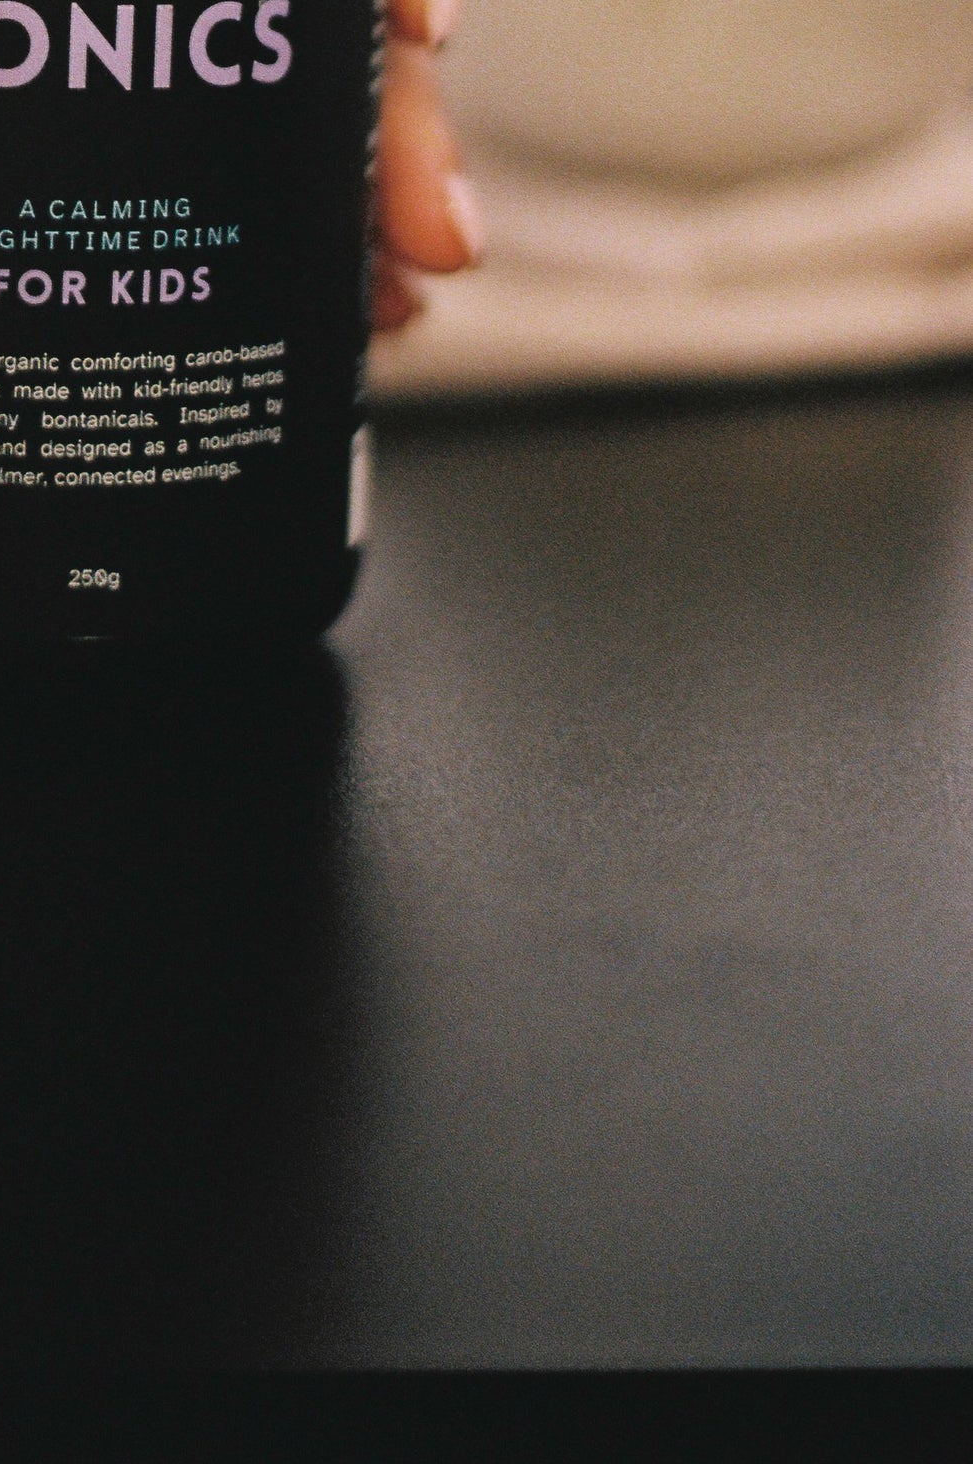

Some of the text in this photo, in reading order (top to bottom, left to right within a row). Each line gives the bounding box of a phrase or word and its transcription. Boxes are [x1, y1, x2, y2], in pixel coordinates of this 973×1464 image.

[19, 197, 191, 219] A CALMING
[153, 225, 240, 249] DRINK
[111, 266, 211, 305] KIDS
[71, 351, 176, 373] comforting
[185, 339, 286, 368] carob-based
[13, 382, 70, 400] made
[81, 381, 123, 400] with
[133, 377, 234, 399] kid-friendly
[242, 369, 285, 388] herbs
[41, 410, 159, 430] bontanicals.
[180, 399, 250, 425] Inspired
[265, 397, 284, 415] by
[40, 434, 132, 462] designed
[144, 440, 166, 457] as
[177, 438, 188, 454] a
[199, 425, 282, 450] nourishing
[54, 466, 156, 486] connected
[68, 568, 121, 590] 250g
